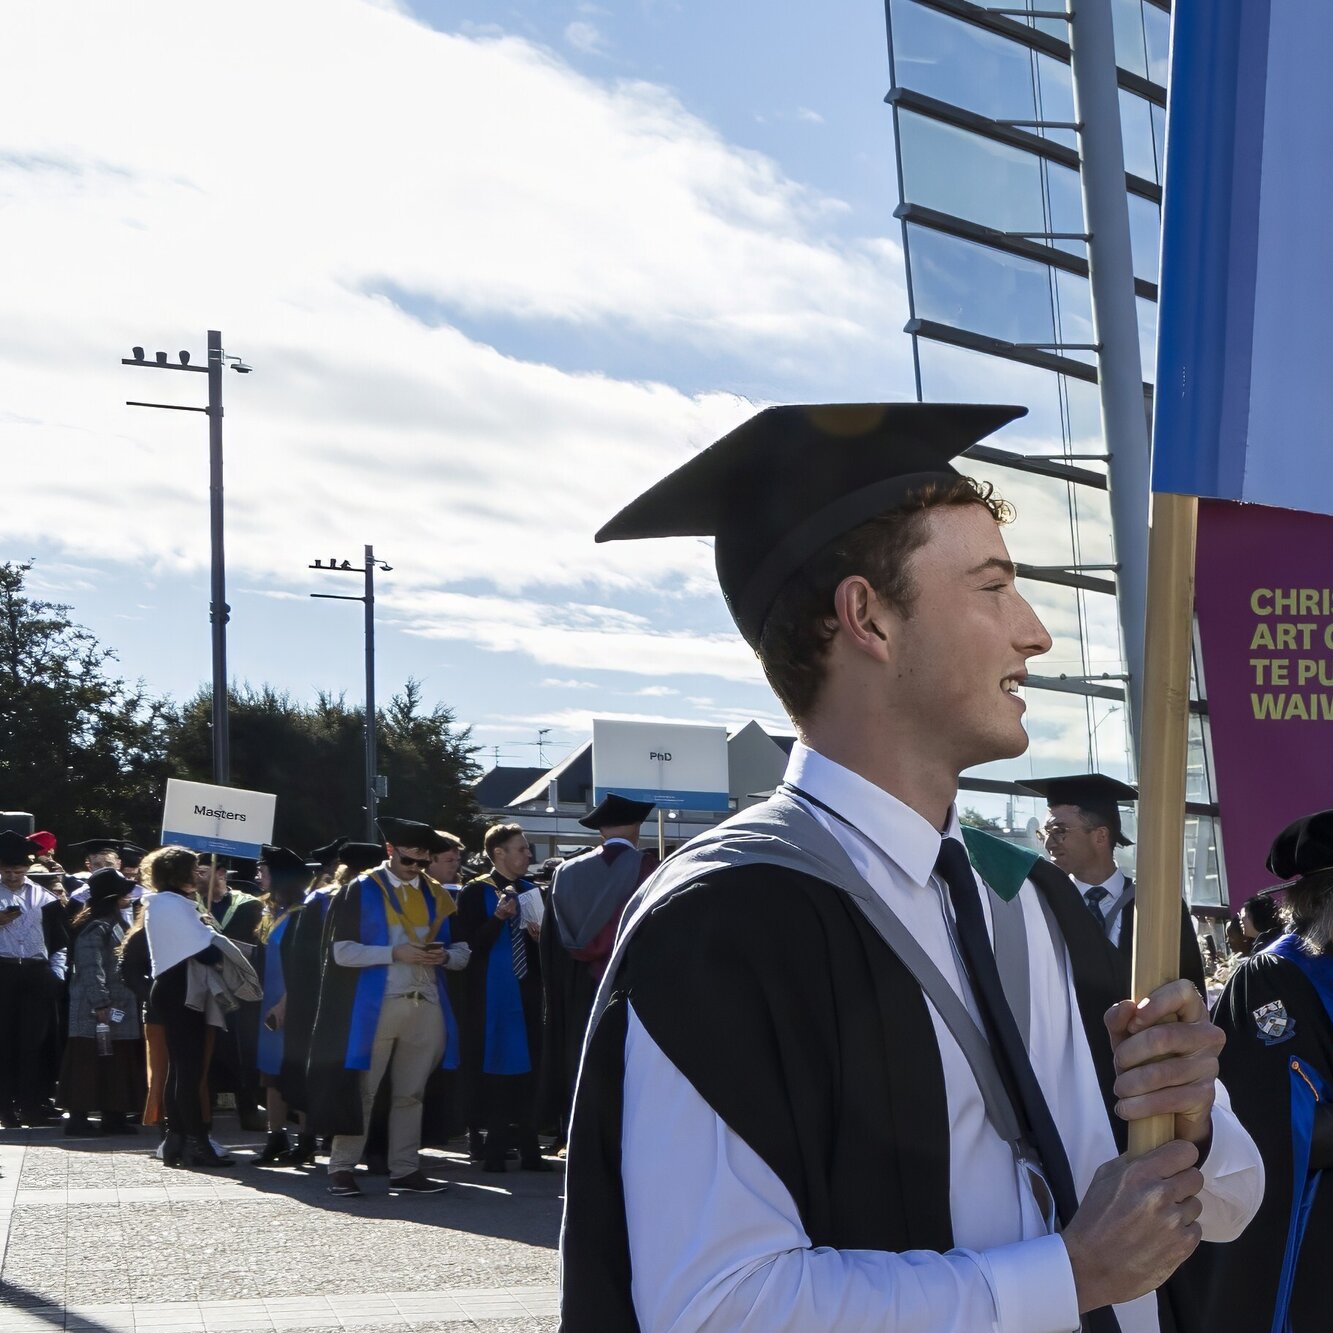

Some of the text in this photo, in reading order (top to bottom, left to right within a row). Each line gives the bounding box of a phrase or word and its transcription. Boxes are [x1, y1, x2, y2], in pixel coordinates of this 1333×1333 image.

[1250, 623, 1317, 650] ART
[1250, 658, 1289, 686] TE
[649, 752, 672, 762] PhD
[193, 805, 247, 822] Masters
